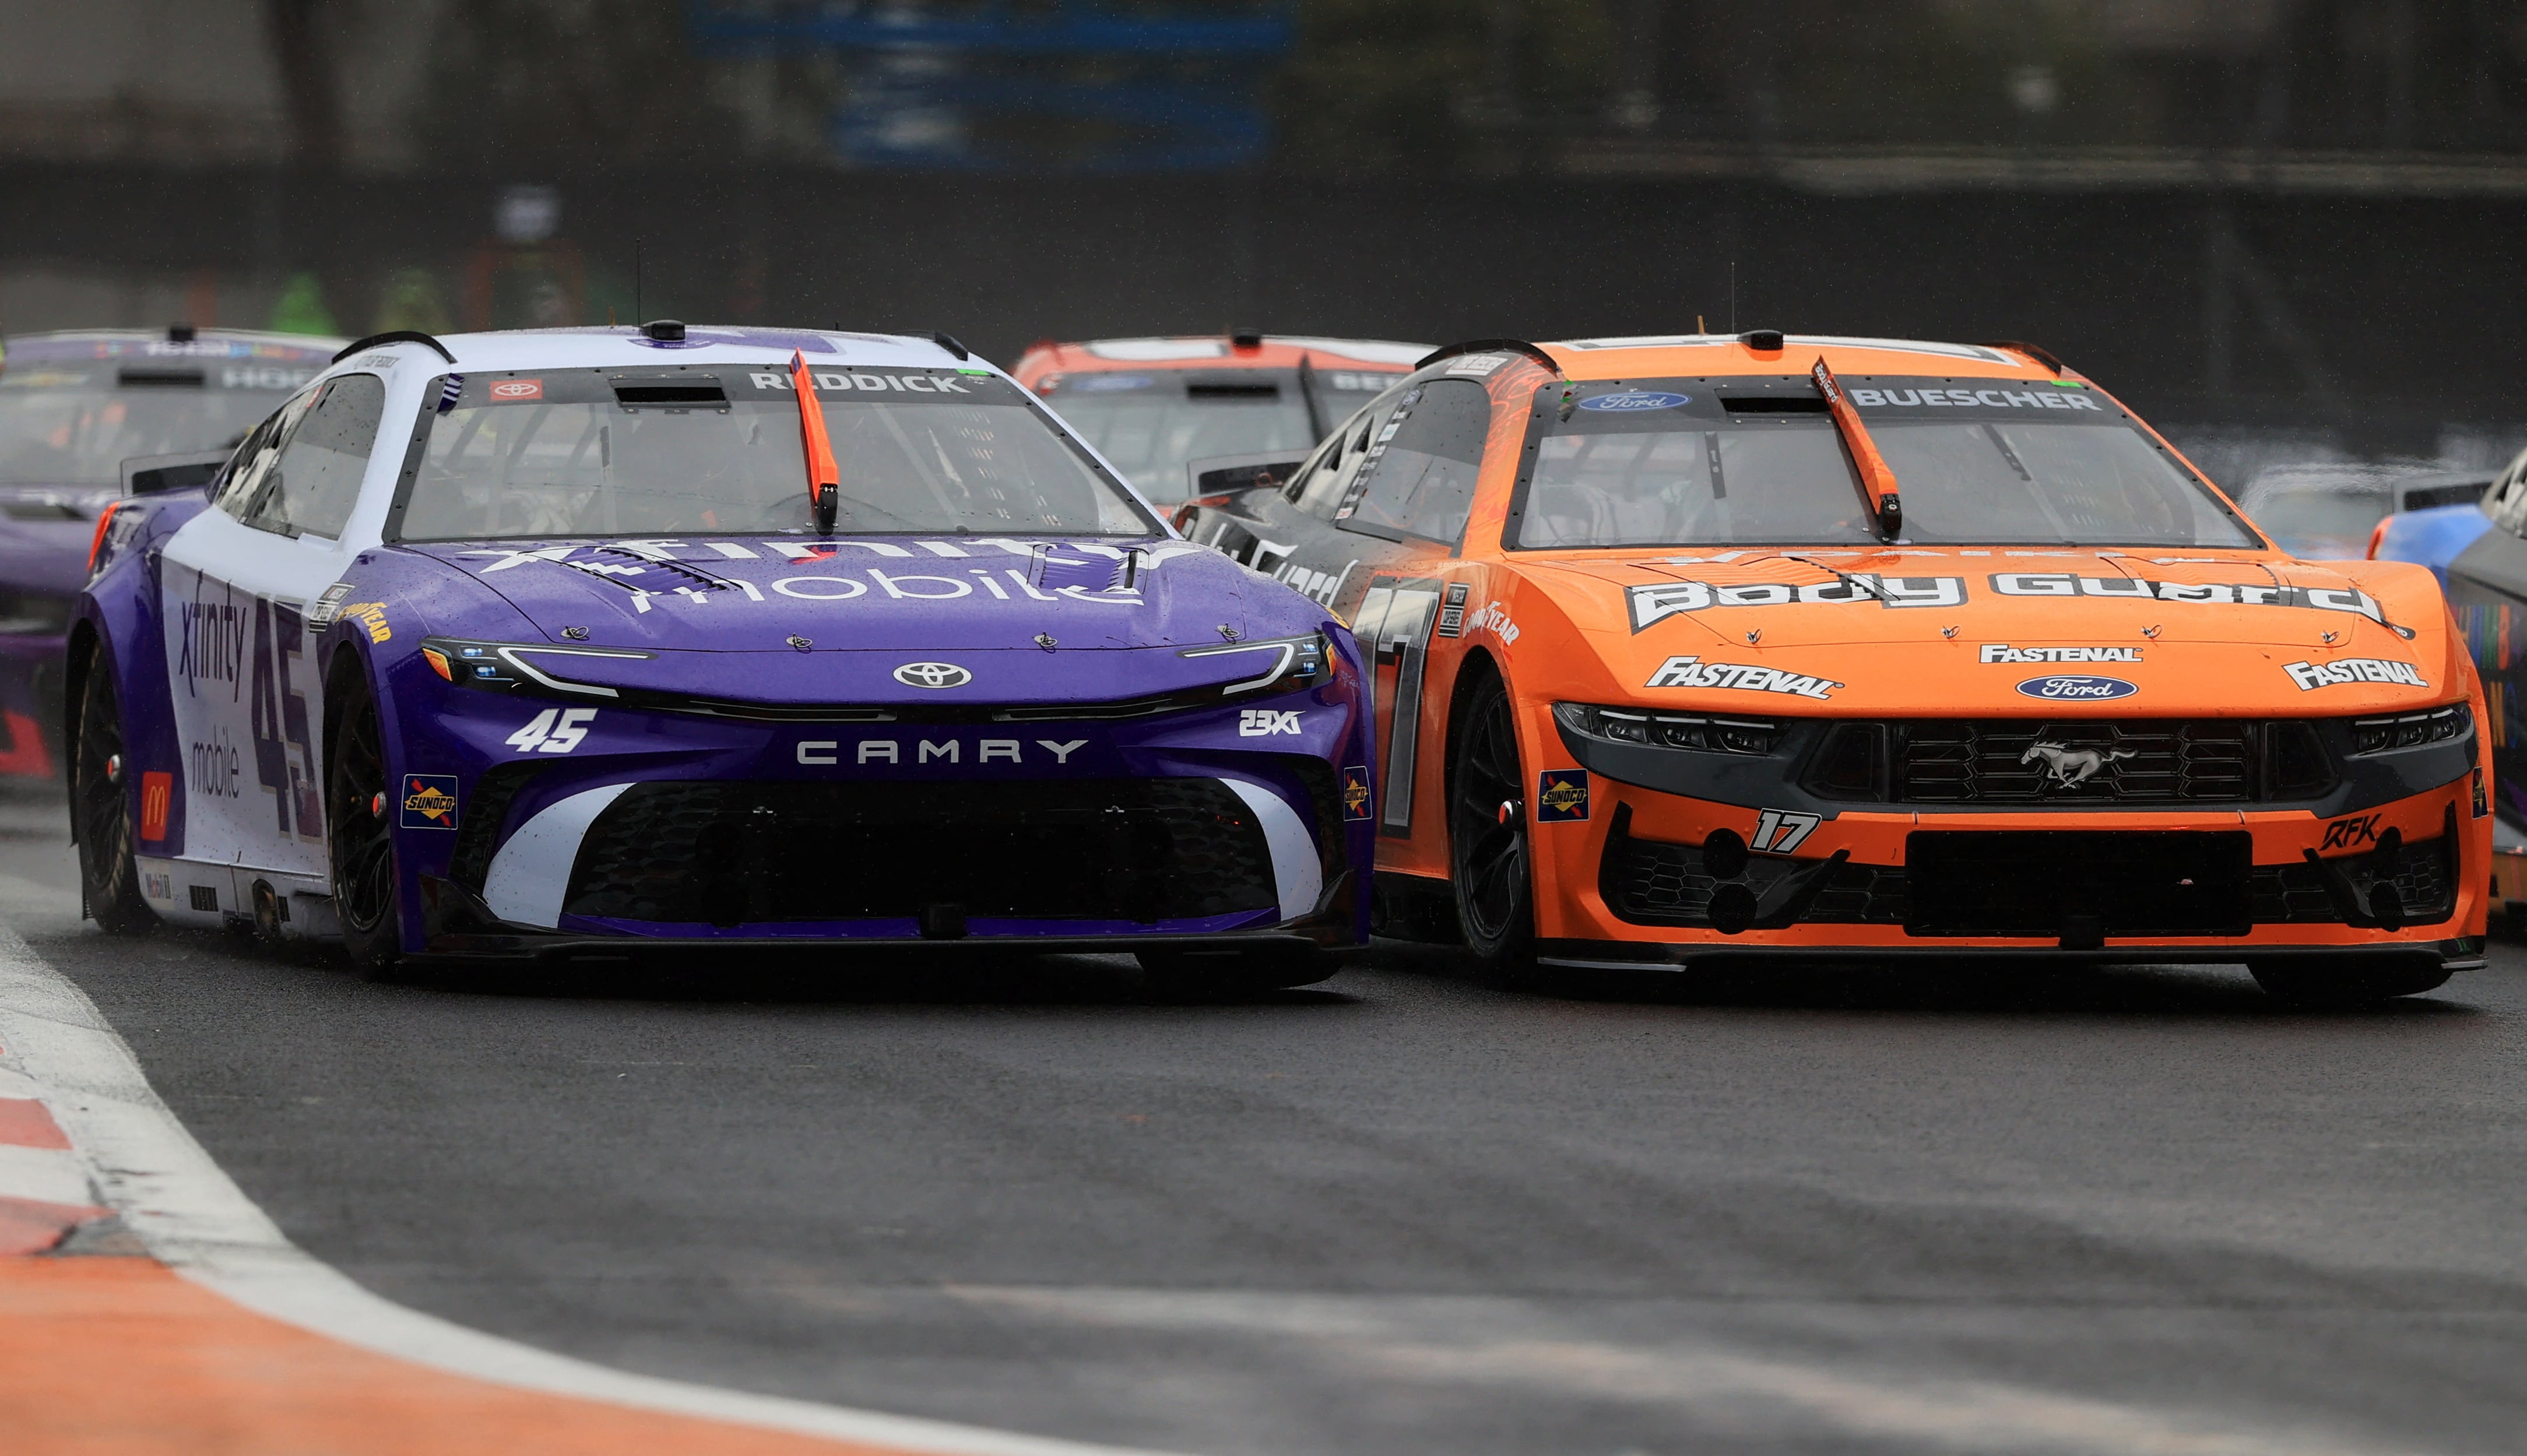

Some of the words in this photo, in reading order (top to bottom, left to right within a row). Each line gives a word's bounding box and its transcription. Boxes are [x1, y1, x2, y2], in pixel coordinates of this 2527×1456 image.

[749, 372, 971, 393] RDDICK
[1600, 394, 1667, 409] Ford
[1850, 389, 2102, 410] BUESCHER
[631, 568, 1144, 614] mobile
[1628, 574, 1968, 635] Body
[1988, 573, 2385, 624] Guard
[178, 568, 247, 703] xfinity
[335, 602, 392, 644] GOODYEAR
[1463, 600, 1520, 647] GOODYEAR
[1979, 645, 2143, 663] FASTENAL
[1644, 656, 1834, 699] FASTENAL
[2041, 678, 2114, 697] Ford
[2282, 659, 2430, 692] FASTENAL
[251, 591, 324, 844] 45
[505, 708, 599, 752] 45
[191, 724, 241, 799] mobile
[797, 740, 1089, 764] CAMRY
[406, 795, 454, 811] SUNOCO
[1542, 788, 1586, 804] SUNOCO
[1749, 808, 1822, 855] 17
[2319, 813, 2382, 851] RFK
